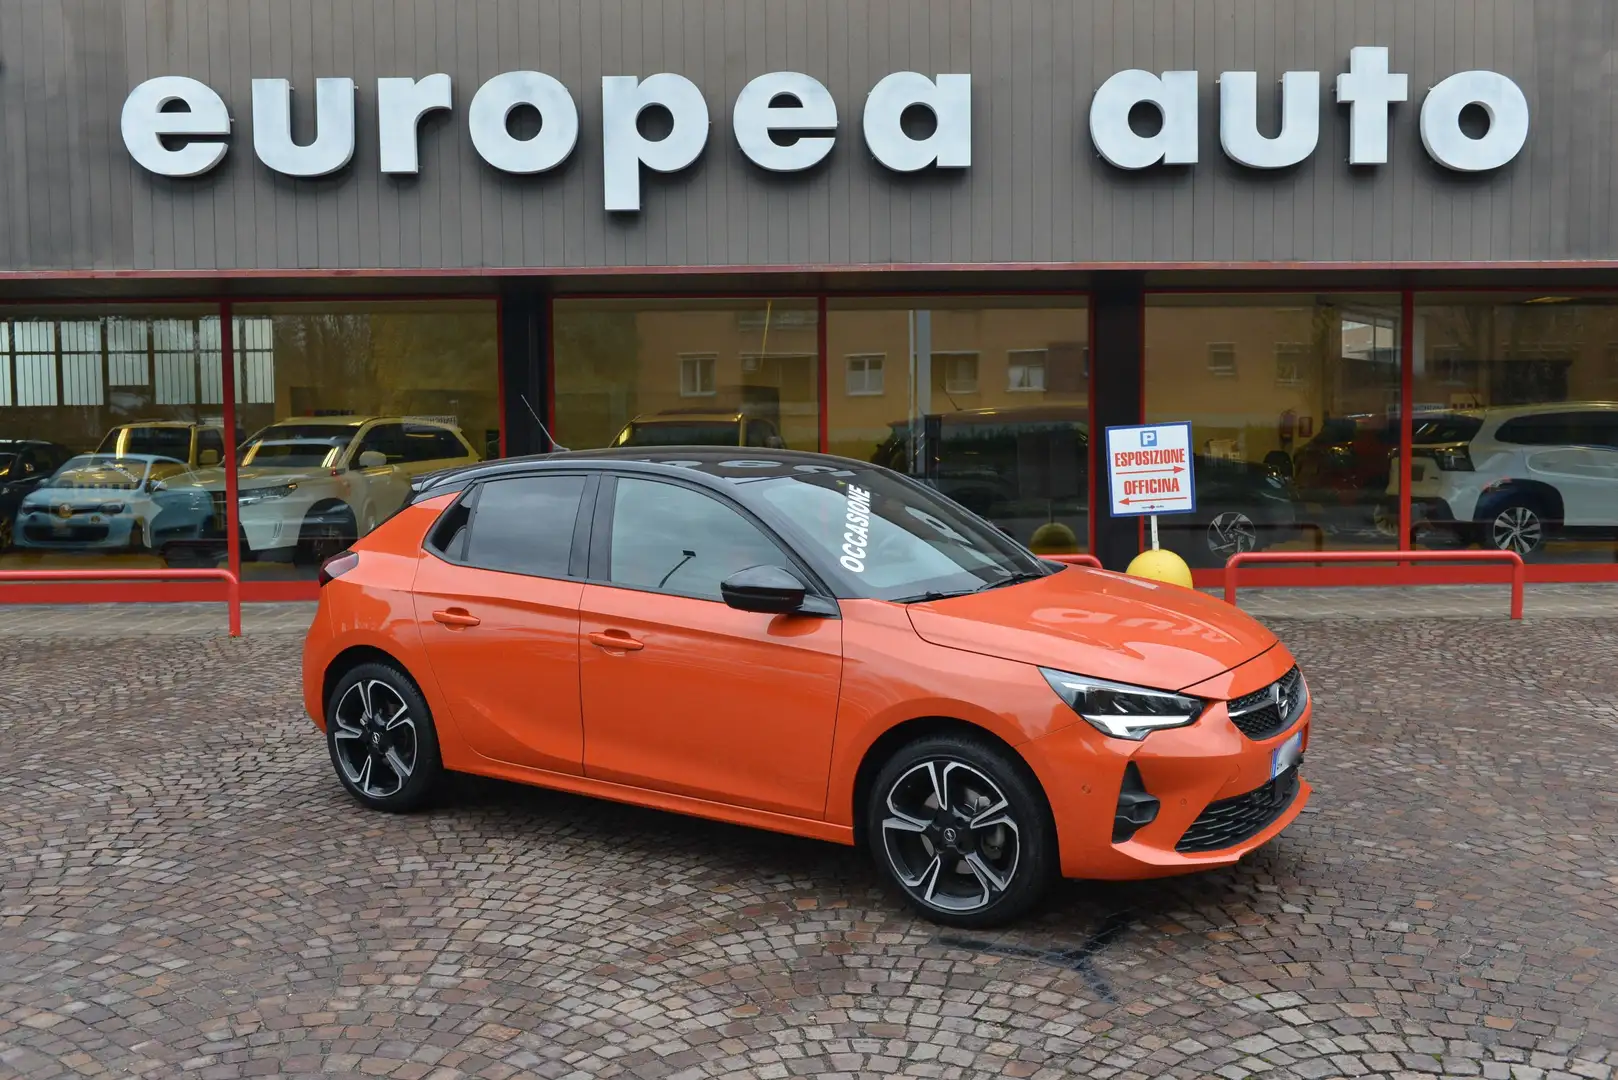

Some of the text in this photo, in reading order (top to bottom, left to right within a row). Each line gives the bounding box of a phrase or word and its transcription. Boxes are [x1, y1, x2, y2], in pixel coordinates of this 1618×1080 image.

[121, 46, 1530, 211] europea auto
[1142, 432, 1156, 446] P
[1114, 448, 1186, 467] ESPOSIZIONE
[1123, 477, 1180, 496] OFFICINA
[840, 483, 871, 573] OCCASIONE
